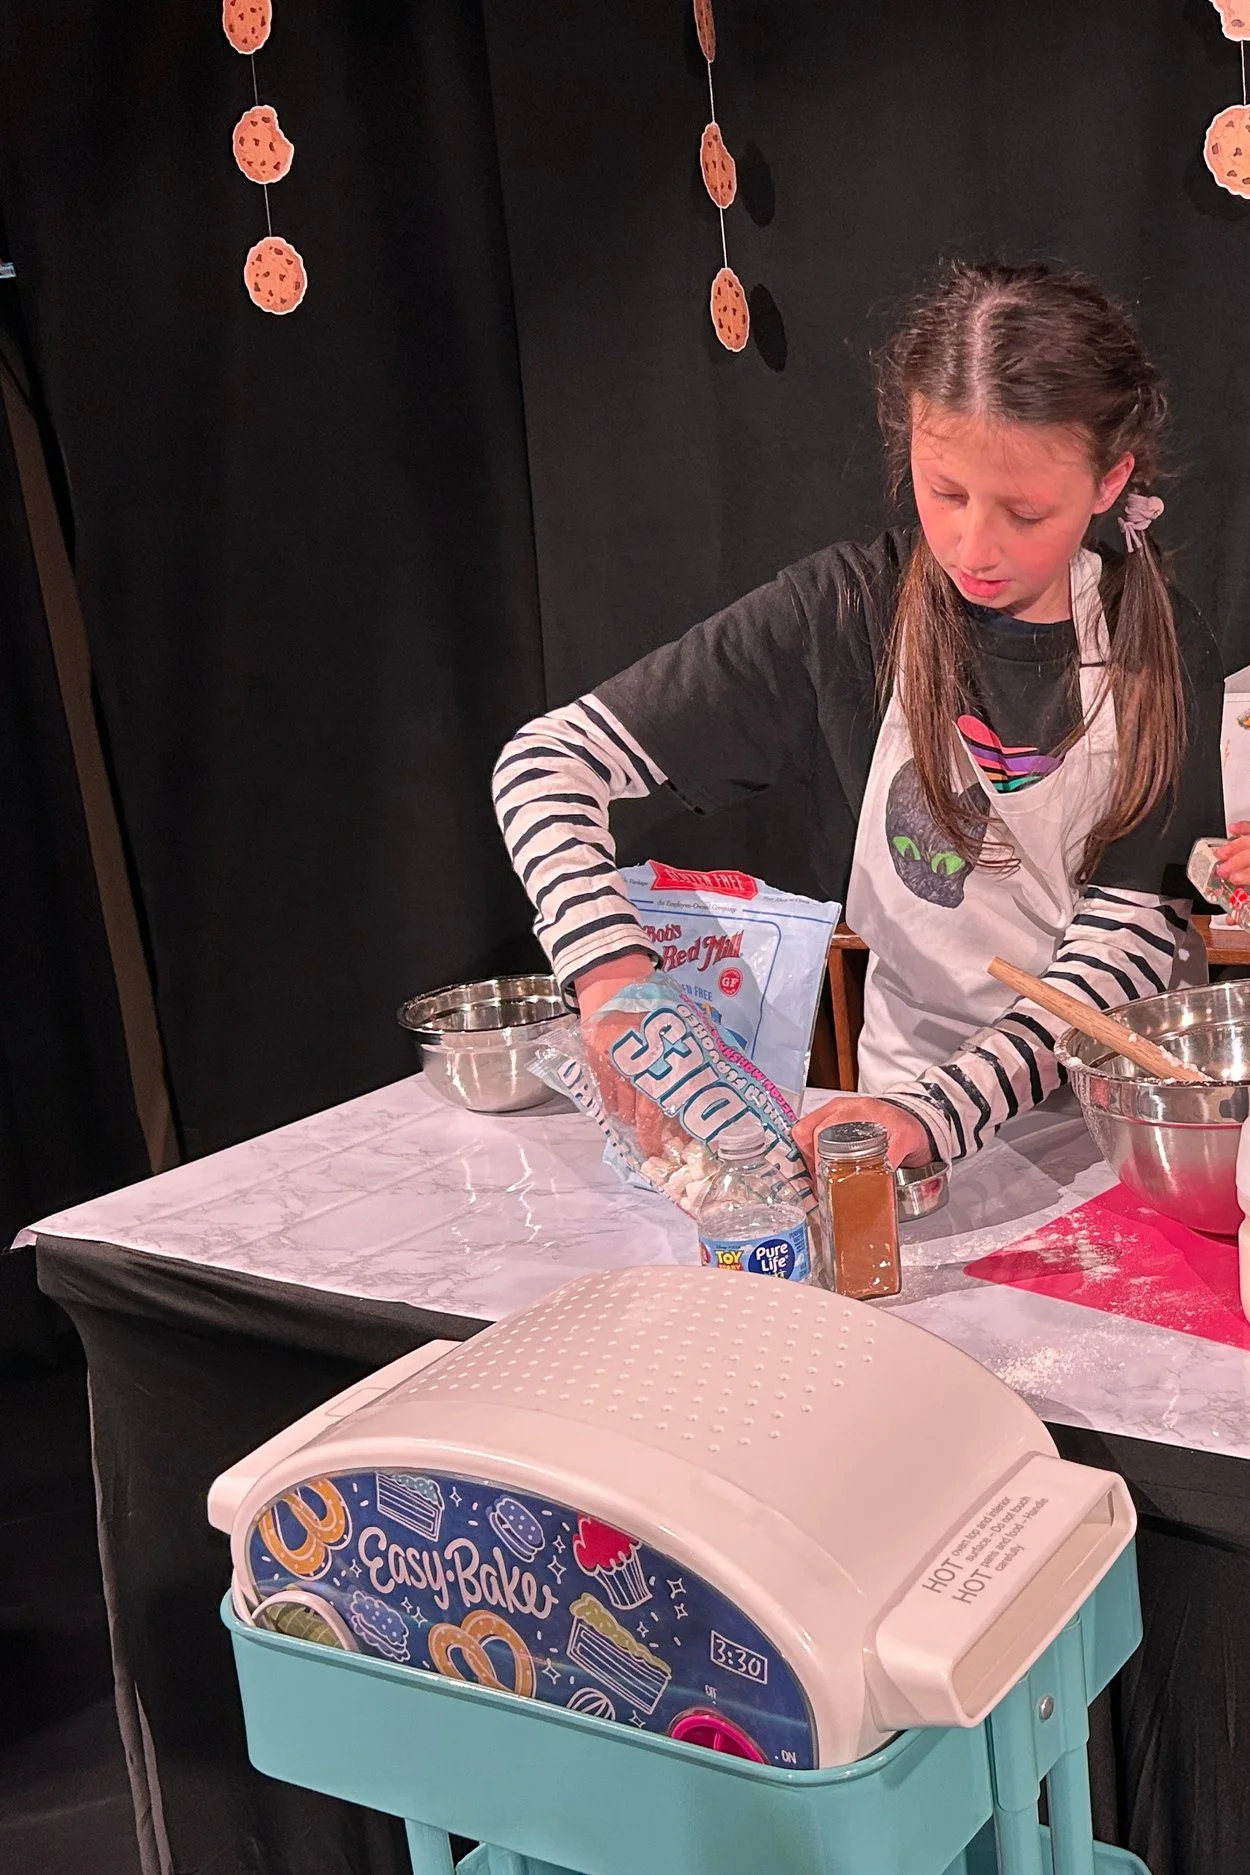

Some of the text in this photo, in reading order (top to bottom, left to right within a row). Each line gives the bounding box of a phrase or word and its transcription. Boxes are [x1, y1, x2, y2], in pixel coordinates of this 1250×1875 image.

[666, 868, 711, 888] GLUTEN
[715, 873, 746, 891] FREE
[662, 929, 744, 972] Red Mill
[721, 976, 739, 989] GF
[694, 986, 713, 1002] FREE
[715, 1249, 744, 1265] TOY
[756, 1243, 789, 1260] Pure
[761, 1255, 787, 1272] Life
[922, 1557, 964, 1594] HOT
[951, 1538, 972, 1557] oven
[976, 1516, 993, 1530] and
[951, 1568, 993, 1604] HOT
[715, 1638, 762, 1677] 3:30
[780, 1749, 797, 1764] ON
